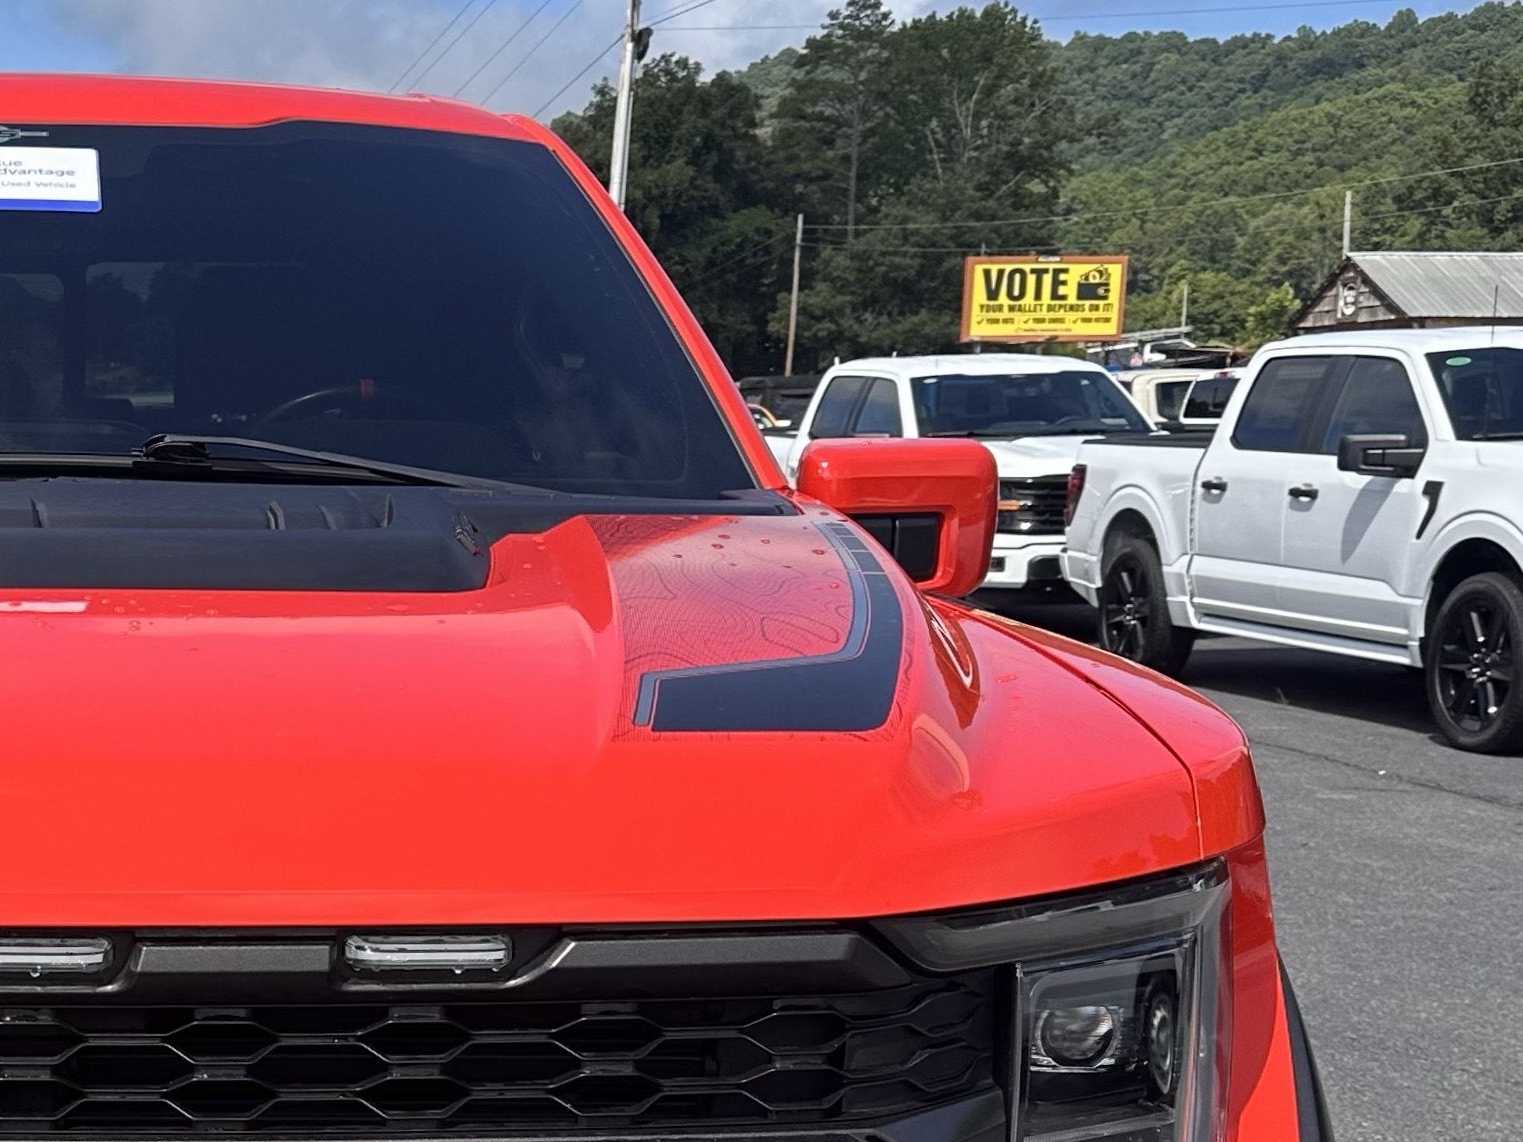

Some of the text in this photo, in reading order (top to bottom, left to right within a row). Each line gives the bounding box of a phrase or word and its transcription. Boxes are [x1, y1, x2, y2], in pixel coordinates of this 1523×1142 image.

[1, 180, 31, 188] Used
[34, 180, 77, 189] Vehicle
[982, 268, 1070, 301] VOTE
[979, 303, 1004, 314] YOUR
[1007, 303, 1043, 314] WALLET
[1046, 303, 1086, 313] DEPENDS
[1088, 303, 1101, 313] ON
